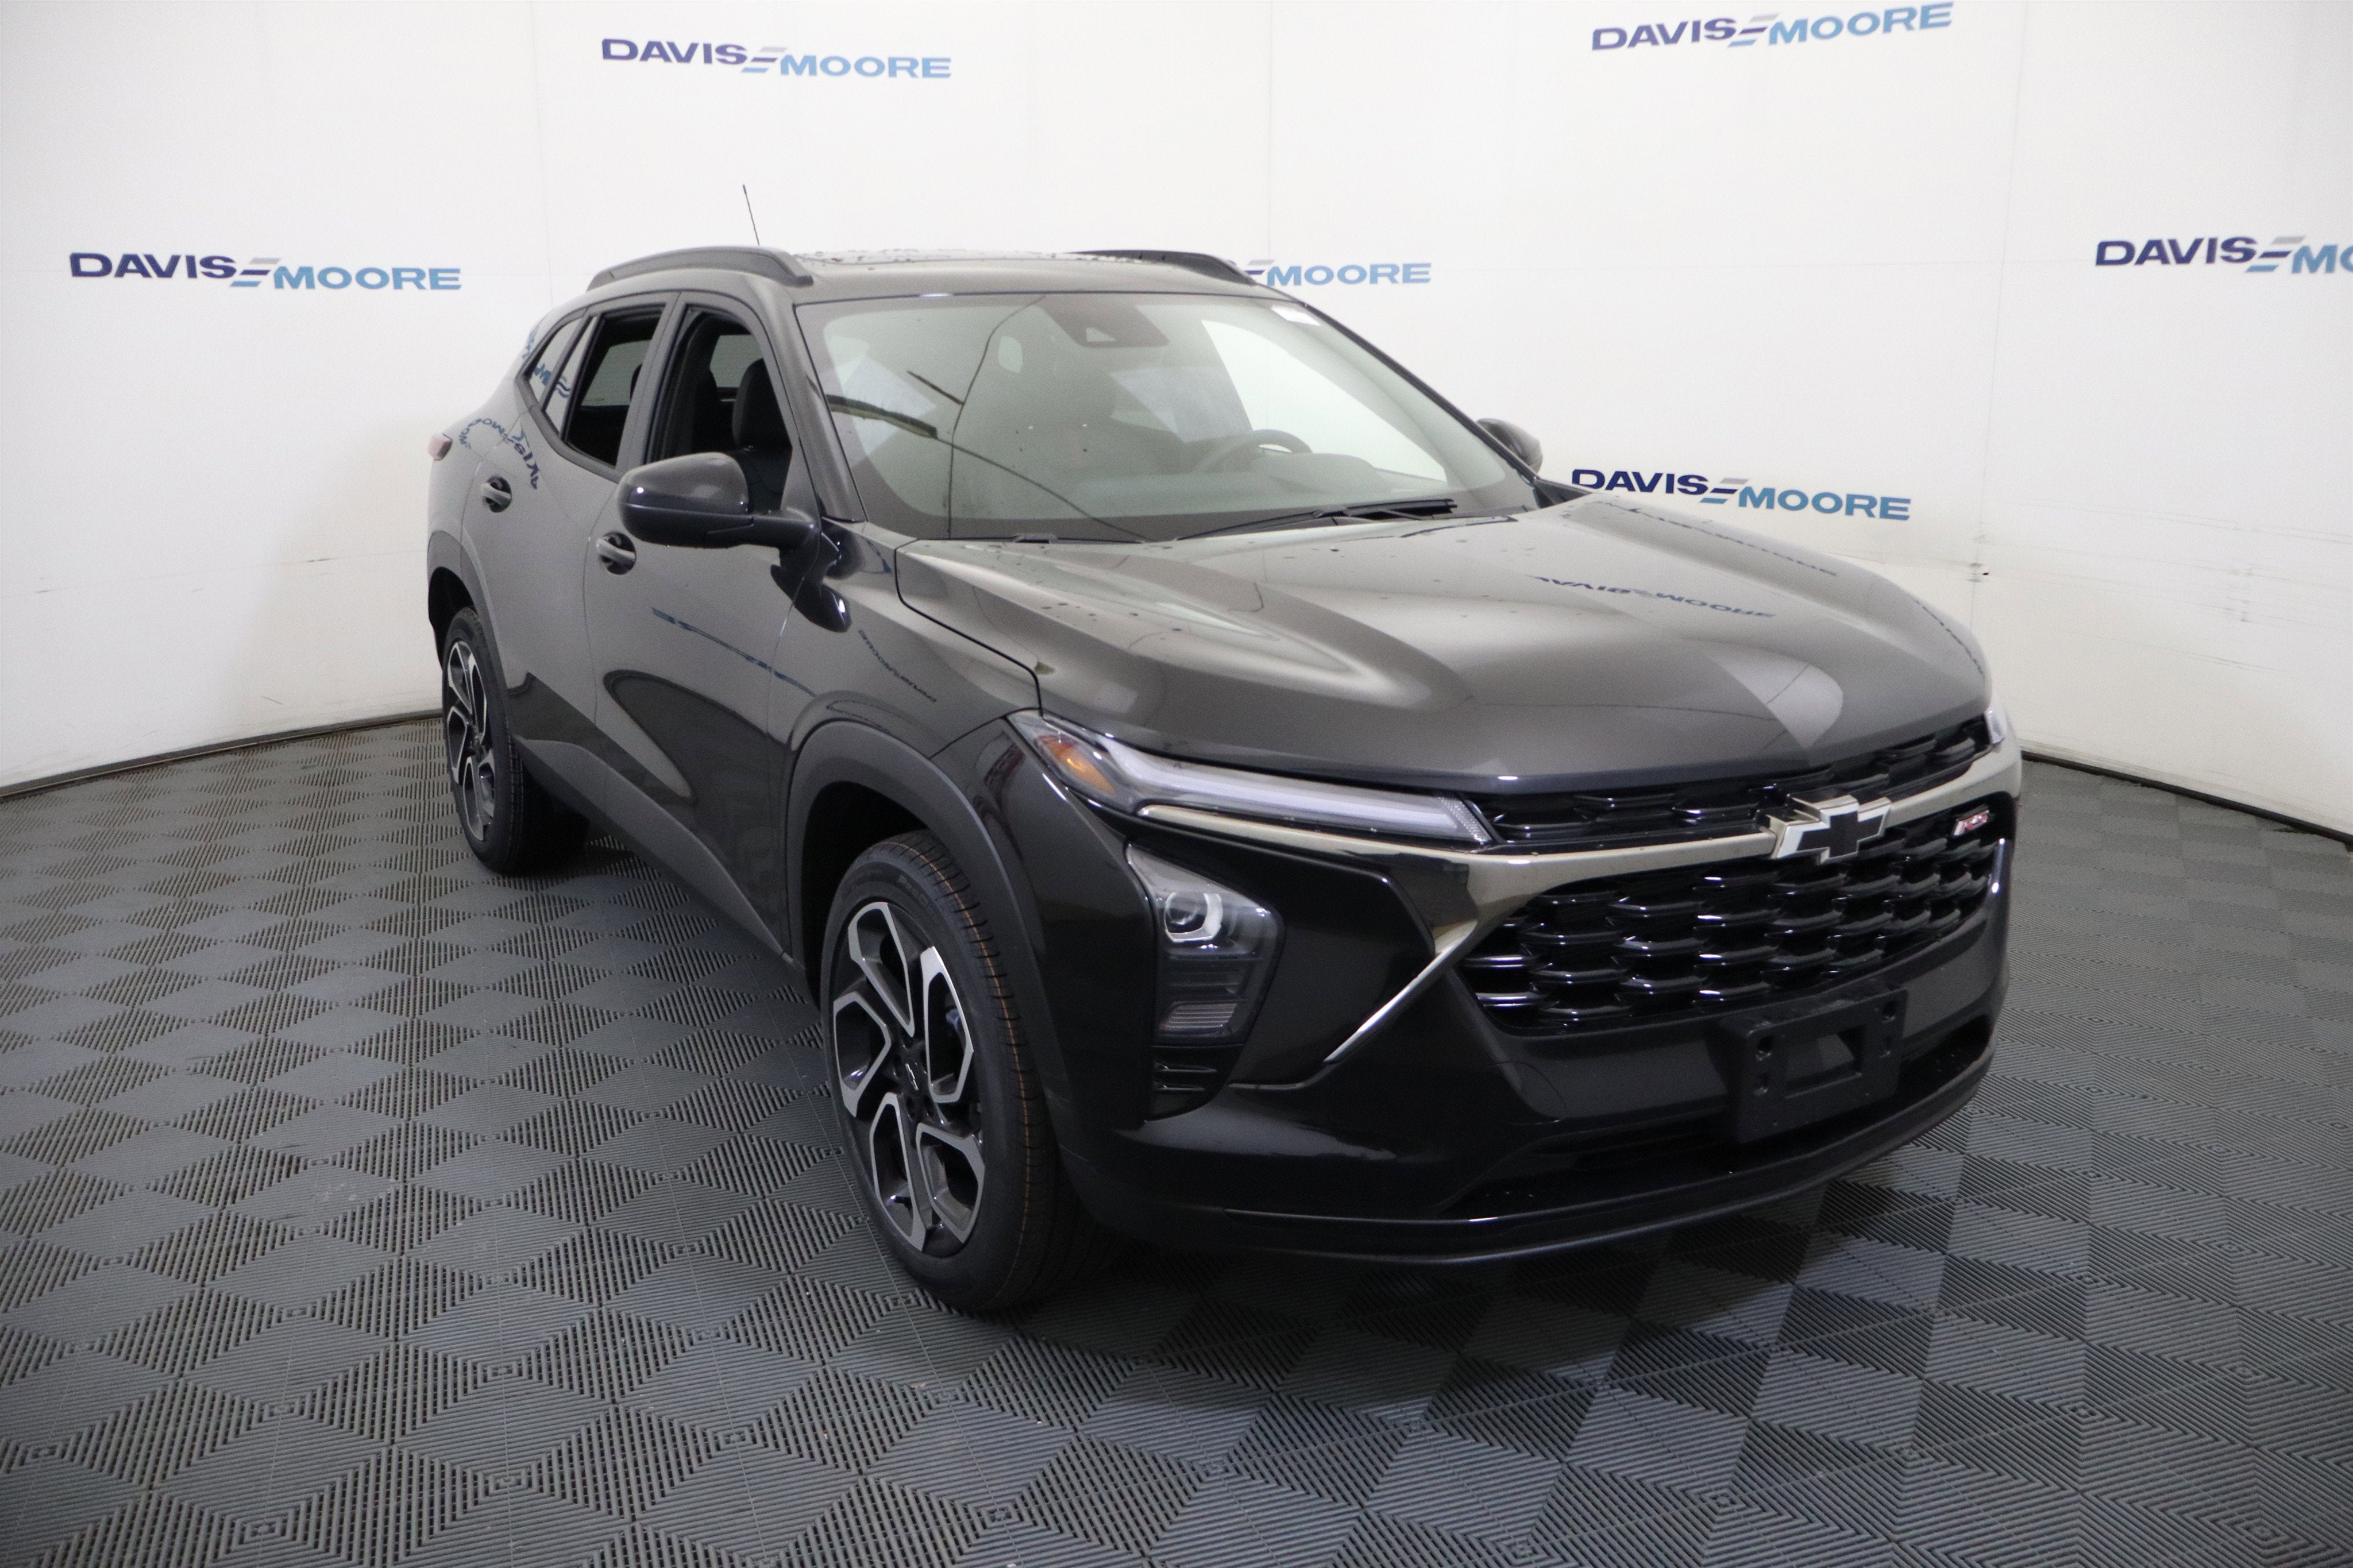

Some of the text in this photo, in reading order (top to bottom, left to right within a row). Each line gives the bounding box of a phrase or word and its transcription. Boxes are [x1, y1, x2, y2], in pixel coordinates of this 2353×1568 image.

[1592, 2, 1954, 51] DAVIS MOORE
[601, 38, 951, 78] DAVIS MOORE
[2095, 236, 2258, 266] DAVIS
[70, 252, 462, 290] DAVIS MOORE
[1266, 262, 1432, 287] MOORE
[1572, 469, 1911, 521] DAVIS MOORE
[1952, 810, 1989, 836] RS
